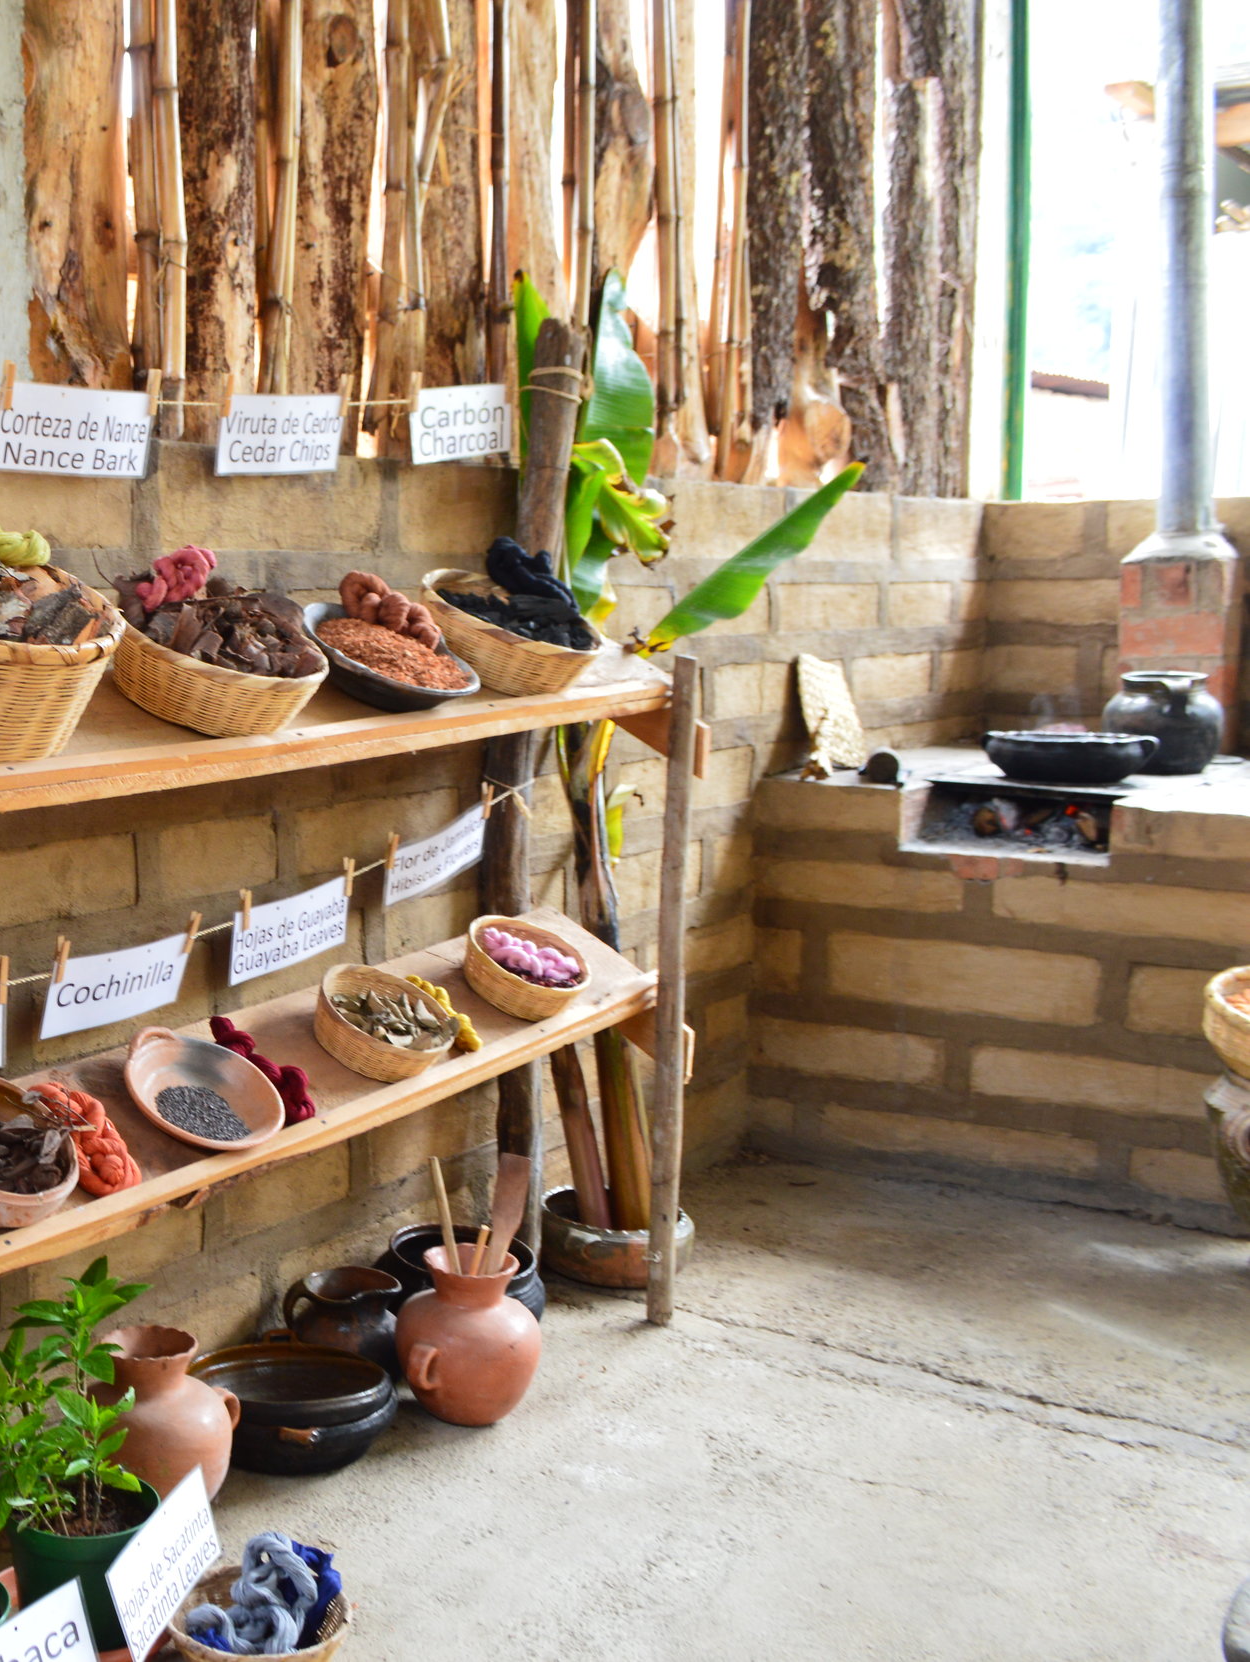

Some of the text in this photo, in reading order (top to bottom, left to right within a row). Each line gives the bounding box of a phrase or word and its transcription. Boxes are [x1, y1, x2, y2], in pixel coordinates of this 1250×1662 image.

[0, 408, 147, 443] Corteza de Nance
[226, 411, 340, 435] Viruta de Cedro
[420, 401, 504, 429] Carbón
[229, 439, 331, 467] Cedar Chips
[419, 422, 503, 456] Charcoal
[3, 441, 138, 472] Nance Bark
[423, 845, 439, 862] de
[234, 896, 345, 953] Hojas de Guayaba
[233, 921, 344, 975] Guayaba Leaves
[56, 960, 174, 1008] Cochinilla
[120, 1507, 210, 1627] Hojas de Sacatinta
[129, 1534, 217, 1660] Sacatinta Leaves
